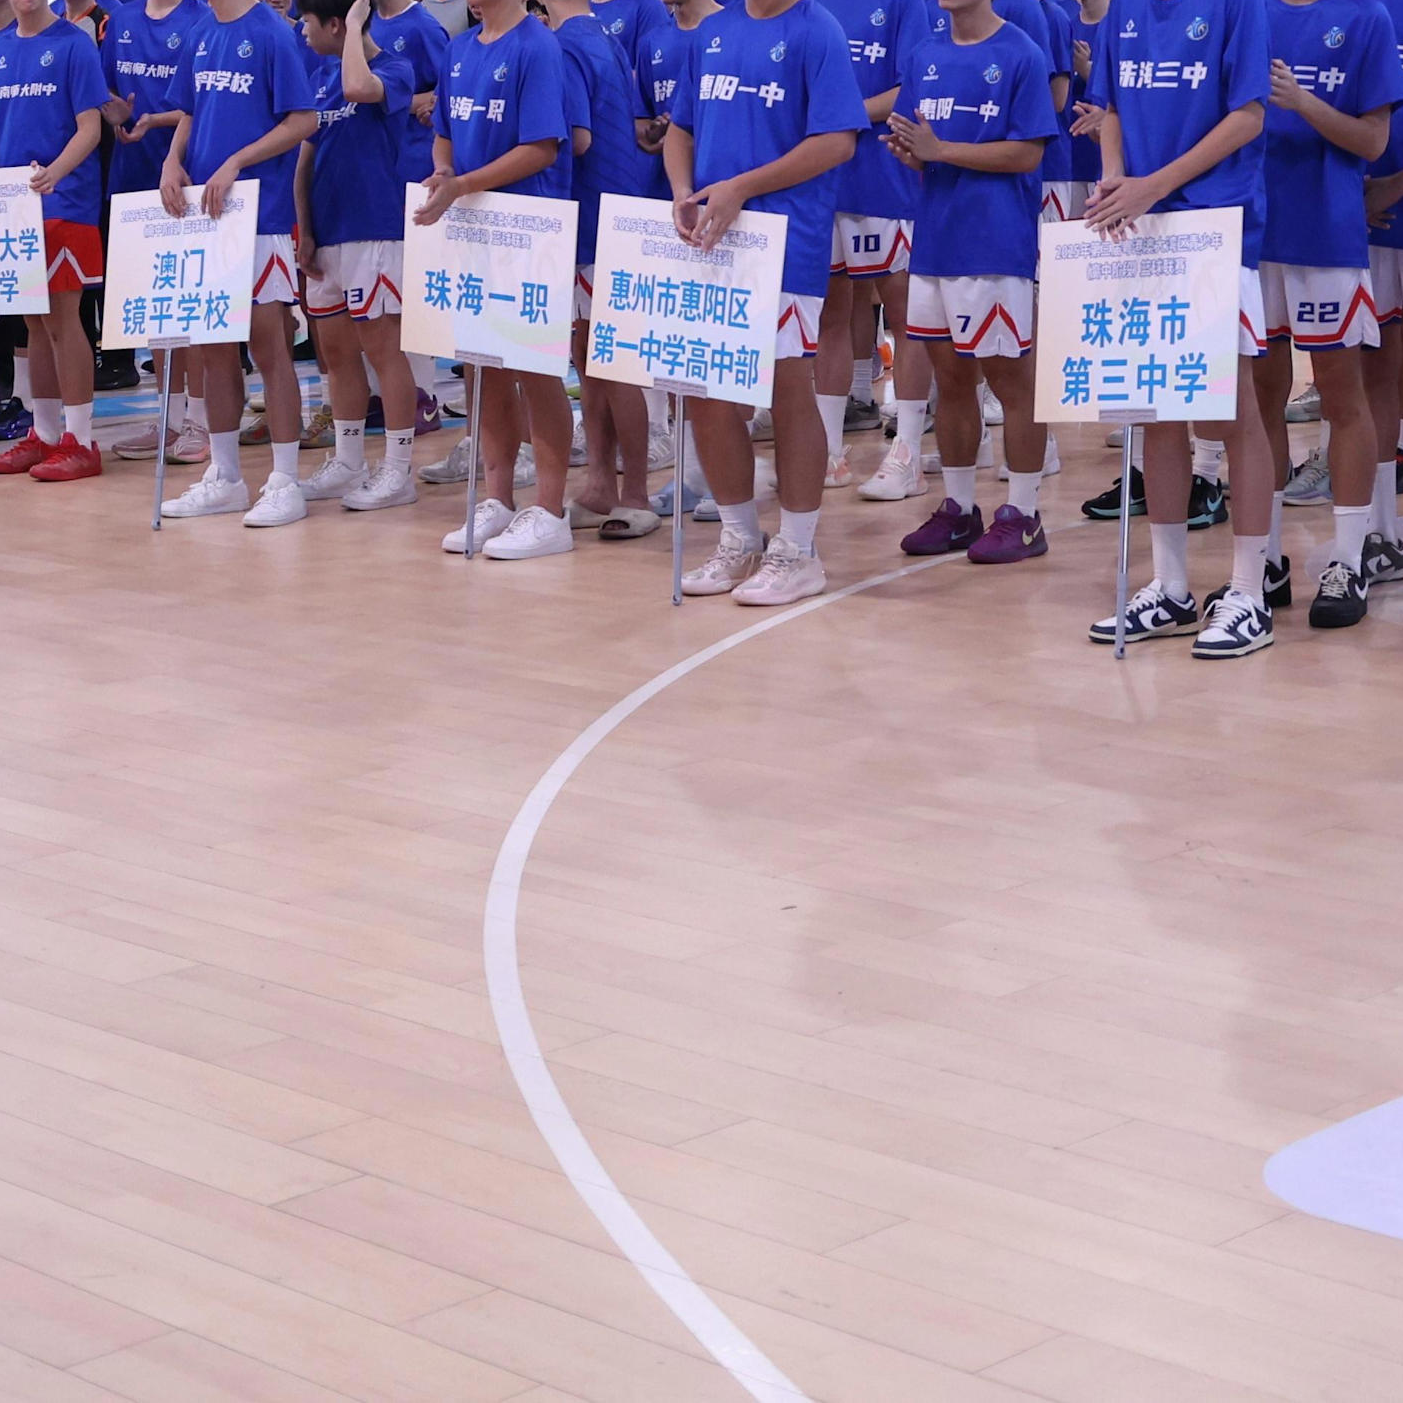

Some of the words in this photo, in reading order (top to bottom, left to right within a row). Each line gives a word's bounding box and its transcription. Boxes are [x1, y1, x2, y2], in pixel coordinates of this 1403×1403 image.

[152, 248, 206, 289] 澳门
[852, 233, 881, 254] 10
[122, 290, 231, 335] 镜平学校
[423, 269, 549, 325] 珠海一职
[607, 269, 752, 330] 惠州市惠阳区
[1080, 294, 1191, 349] 珠海市
[1297, 301, 1341, 324] 22
[955, 314, 972, 334] 7
[591, 320, 761, 390] 第一中学高中部
[1060, 351, 1208, 406] 第三中学
